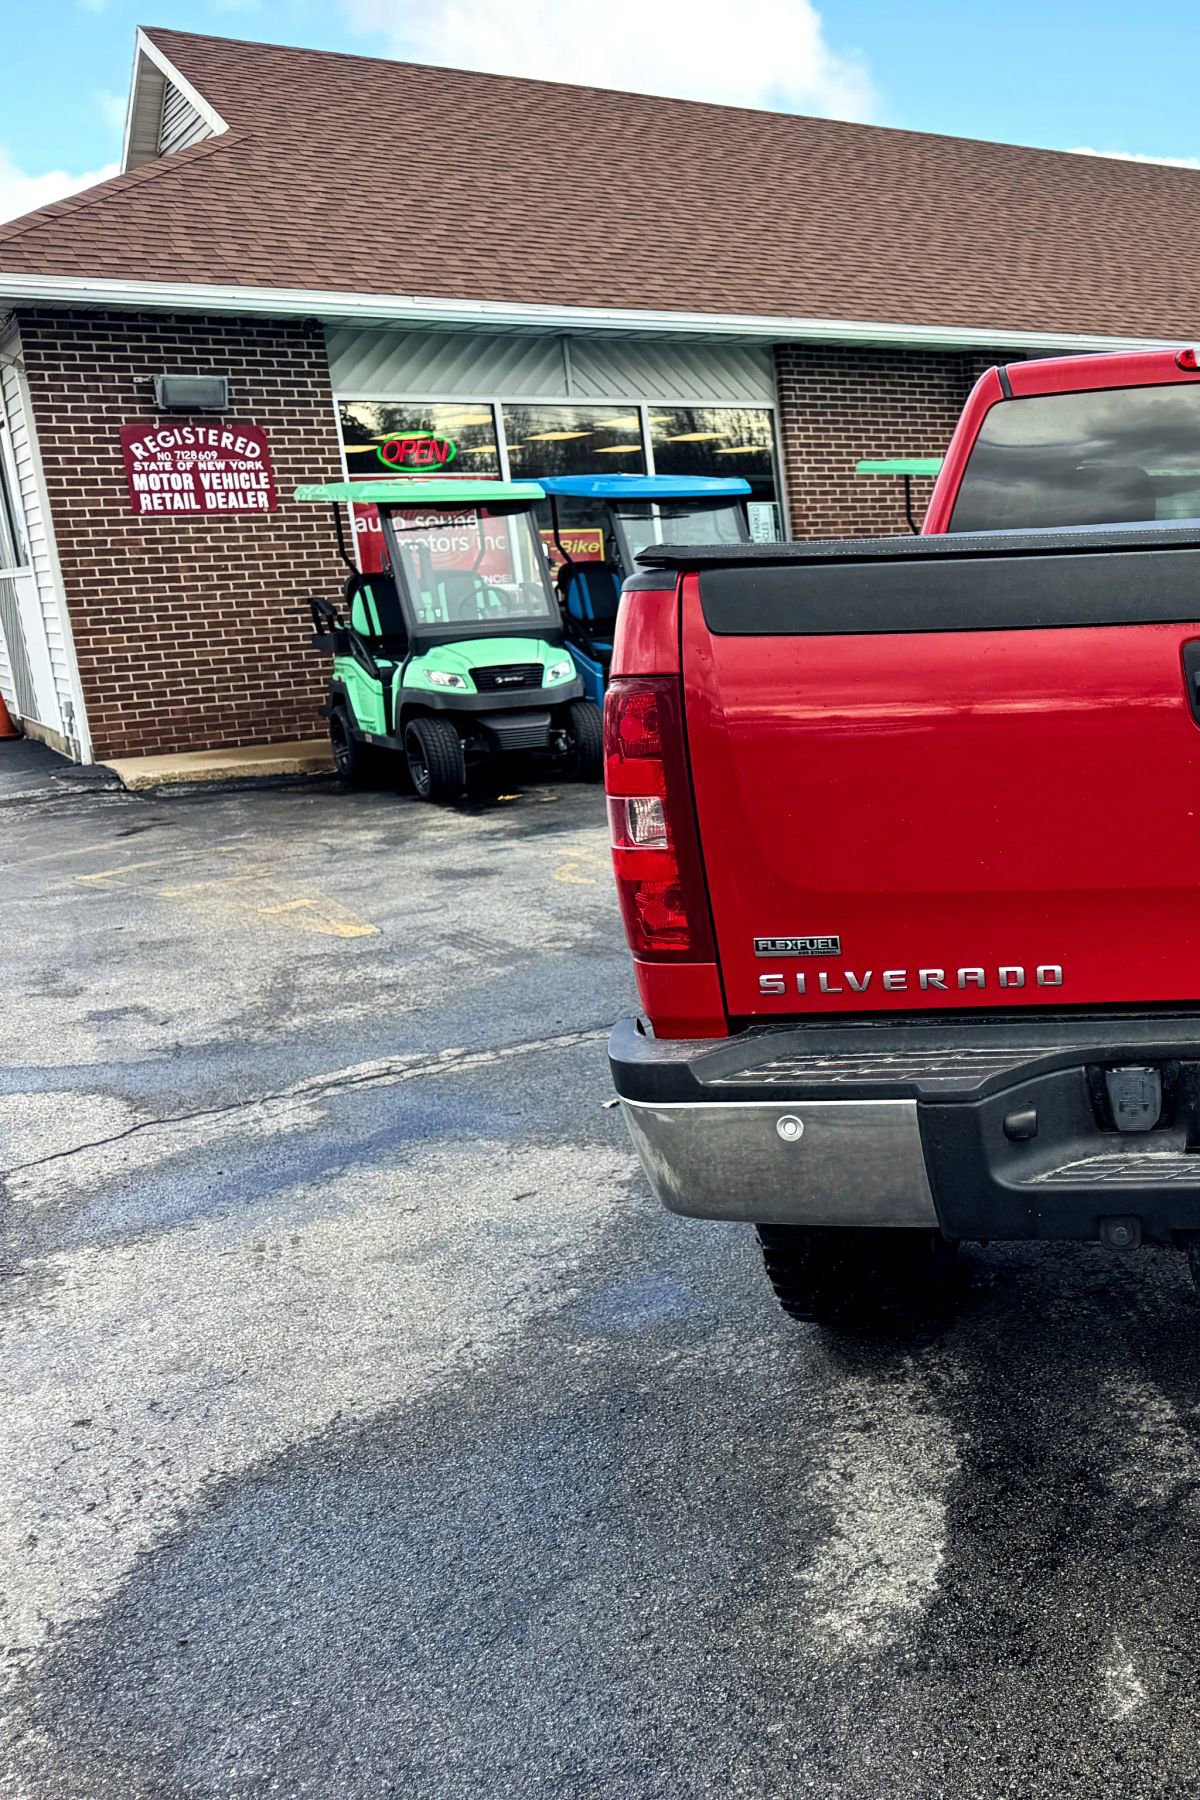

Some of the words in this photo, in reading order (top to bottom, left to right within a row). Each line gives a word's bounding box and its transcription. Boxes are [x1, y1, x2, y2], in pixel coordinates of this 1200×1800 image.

[129, 427, 261, 460] REGISTERED
[382, 439, 449, 463] OPEN
[133, 461, 173, 471] STATE
[177, 461, 194, 471] OF
[198, 461, 227, 471] NEW
[229, 460, 264, 470] YORK
[132, 473, 195, 491] MOTOR
[200, 472, 270, 490] VEHICLE
[140, 492, 201, 511] RETAIL
[205, 491, 269, 509] DEALER
[355, 515, 405, 533] auo
[544, 539, 600, 553] -Bike
[758, 939, 837, 951] FLEXFUEL
[759, 964, 1063, 995] SILVERADO
